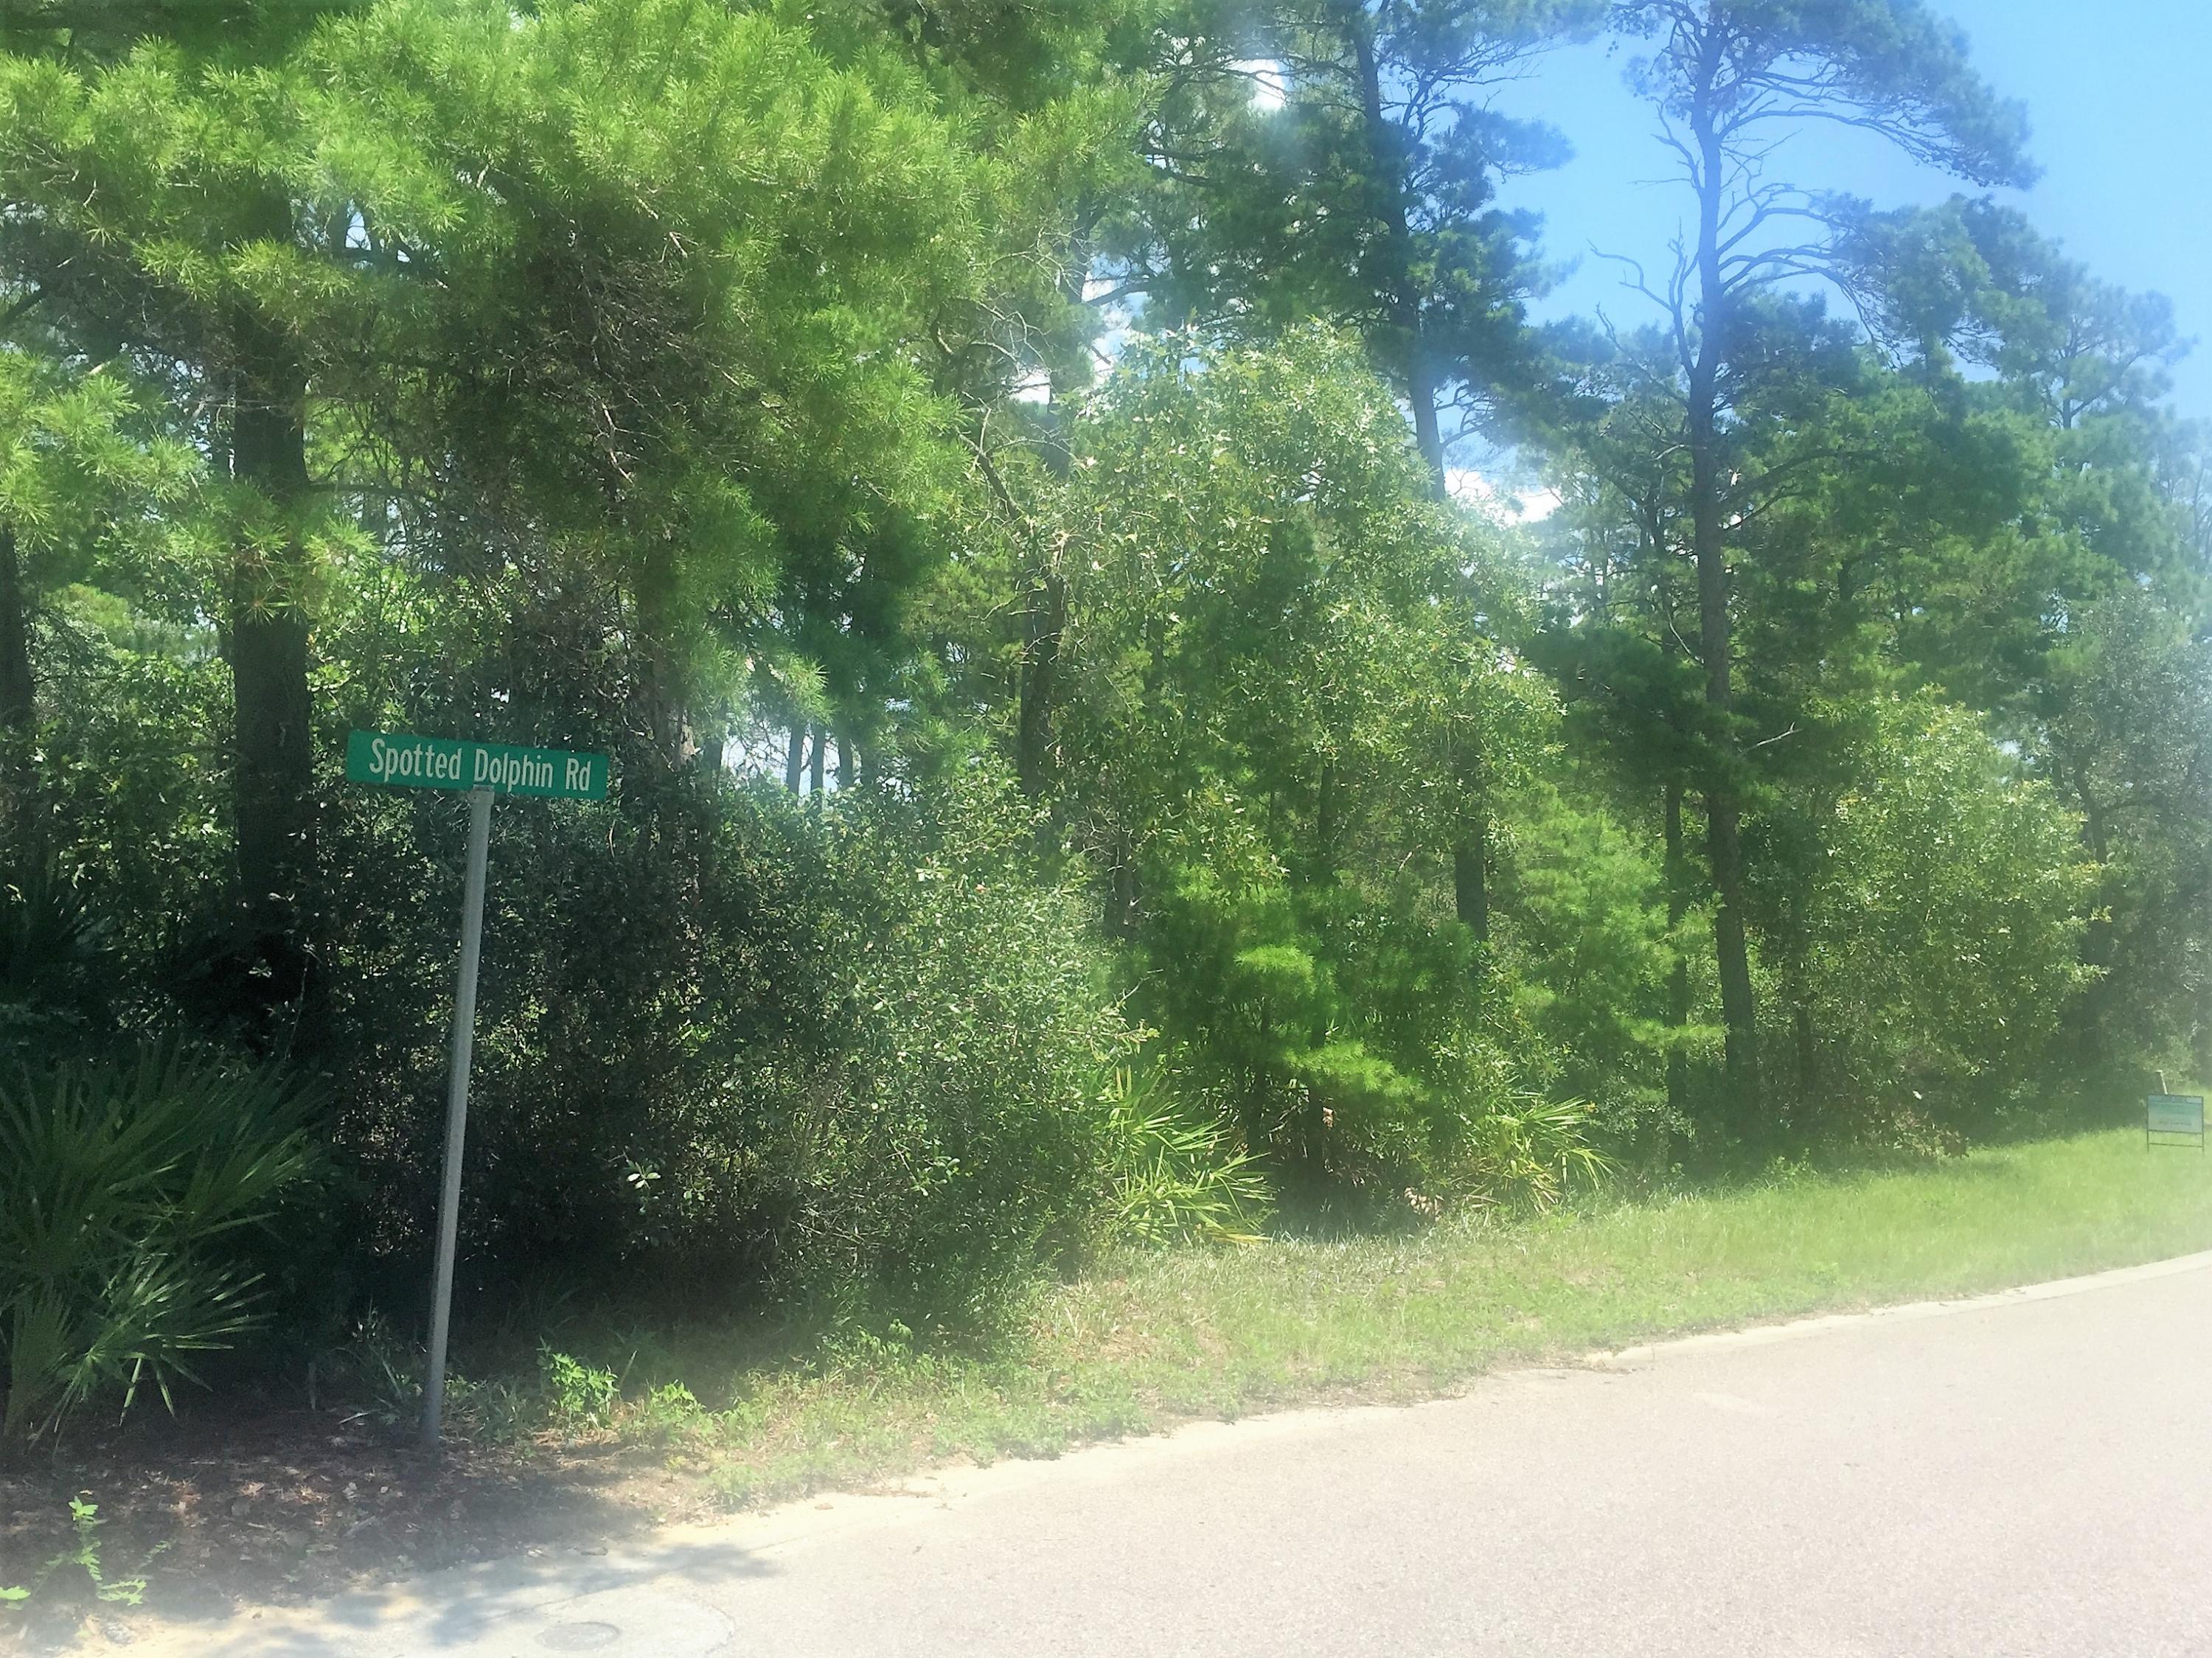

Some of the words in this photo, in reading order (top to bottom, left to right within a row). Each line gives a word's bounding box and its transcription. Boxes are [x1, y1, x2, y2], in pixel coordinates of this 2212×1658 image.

[369, 738, 462, 782] Spotted
[473, 748, 553, 793] Dolphin
[565, 758, 591, 791] Rd
